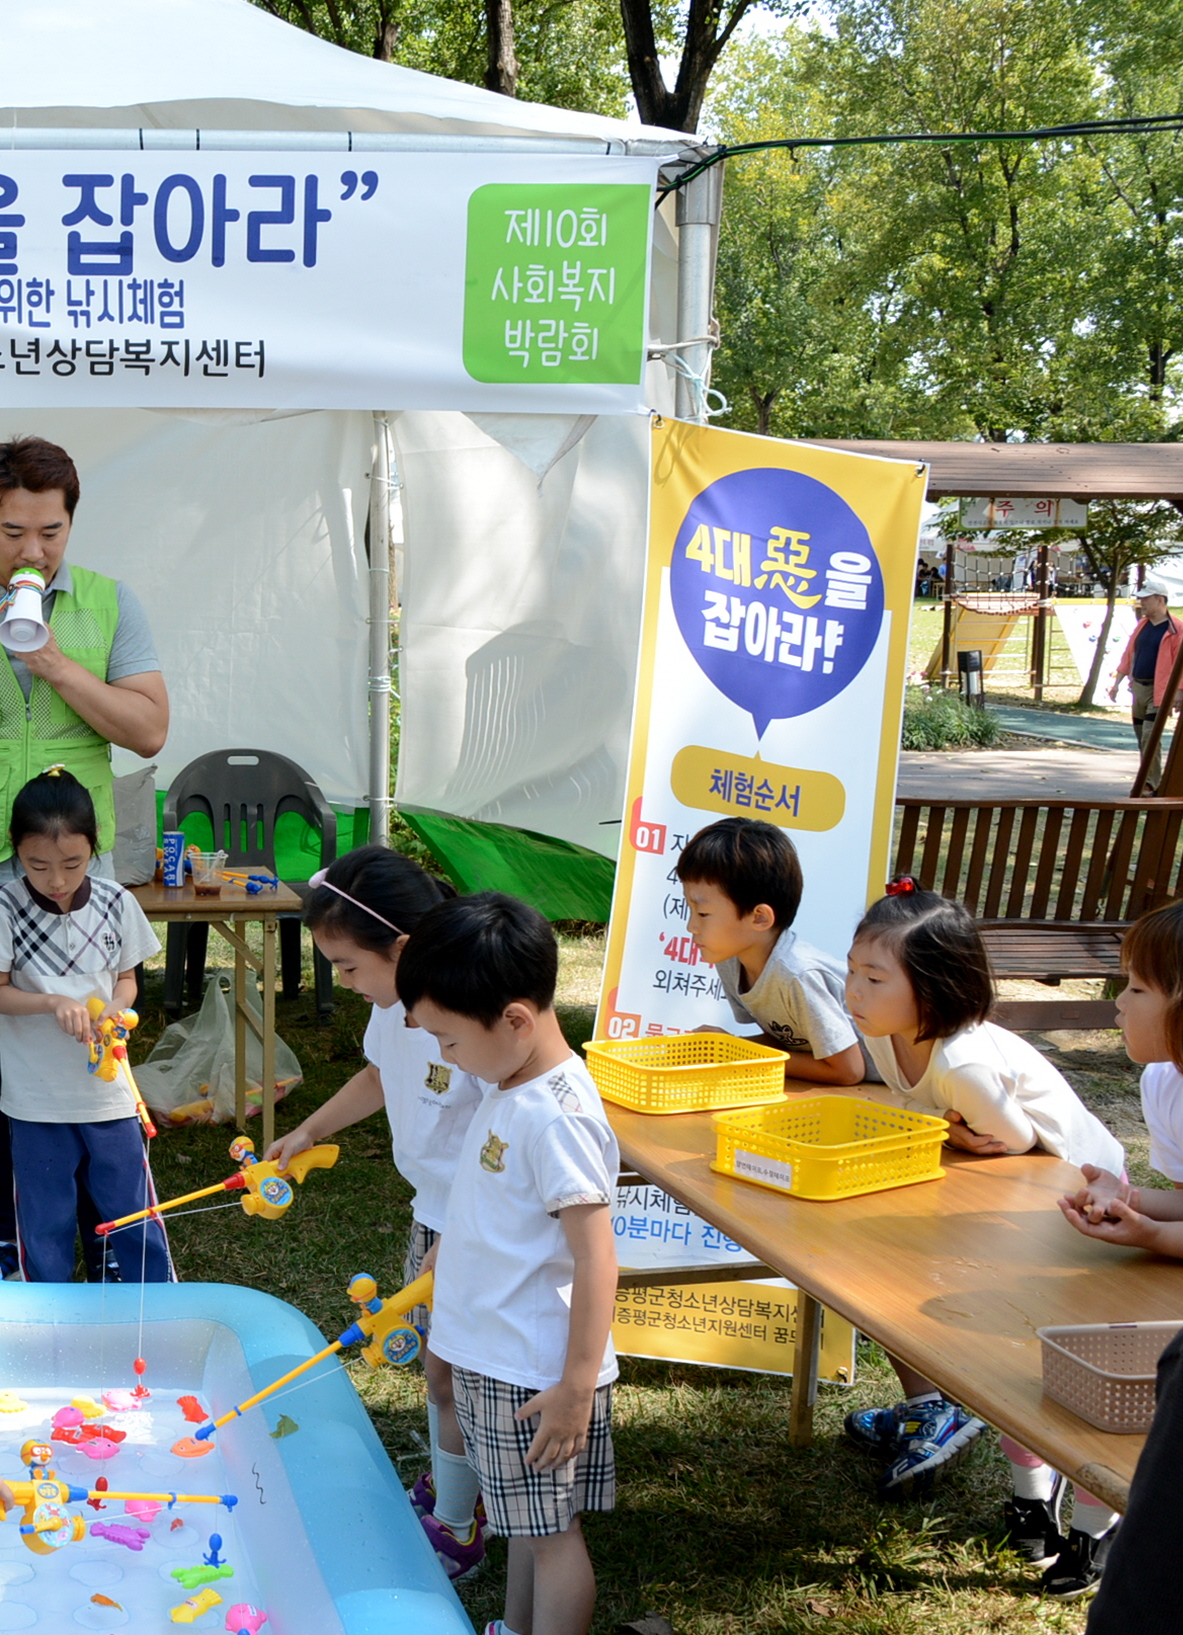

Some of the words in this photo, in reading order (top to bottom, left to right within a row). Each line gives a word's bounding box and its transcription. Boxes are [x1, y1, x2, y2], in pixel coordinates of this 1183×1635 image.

[61, 170, 379, 276] 잡아라”
[505, 208, 608, 248] 제10회
[65, 278, 185, 329] 낚시체험
[491, 261, 616, 312] 사회복지
[505, 320, 600, 369] 박람회
[685, 523, 752, 588] 4대
[708, 768, 802, 817] 체험순서
[635, 825, 661, 851] 01
[663, 893, 689, 921] (제
[608, 1016, 636, 1039] 02
[611, 1215, 692, 1246] 0분마다
